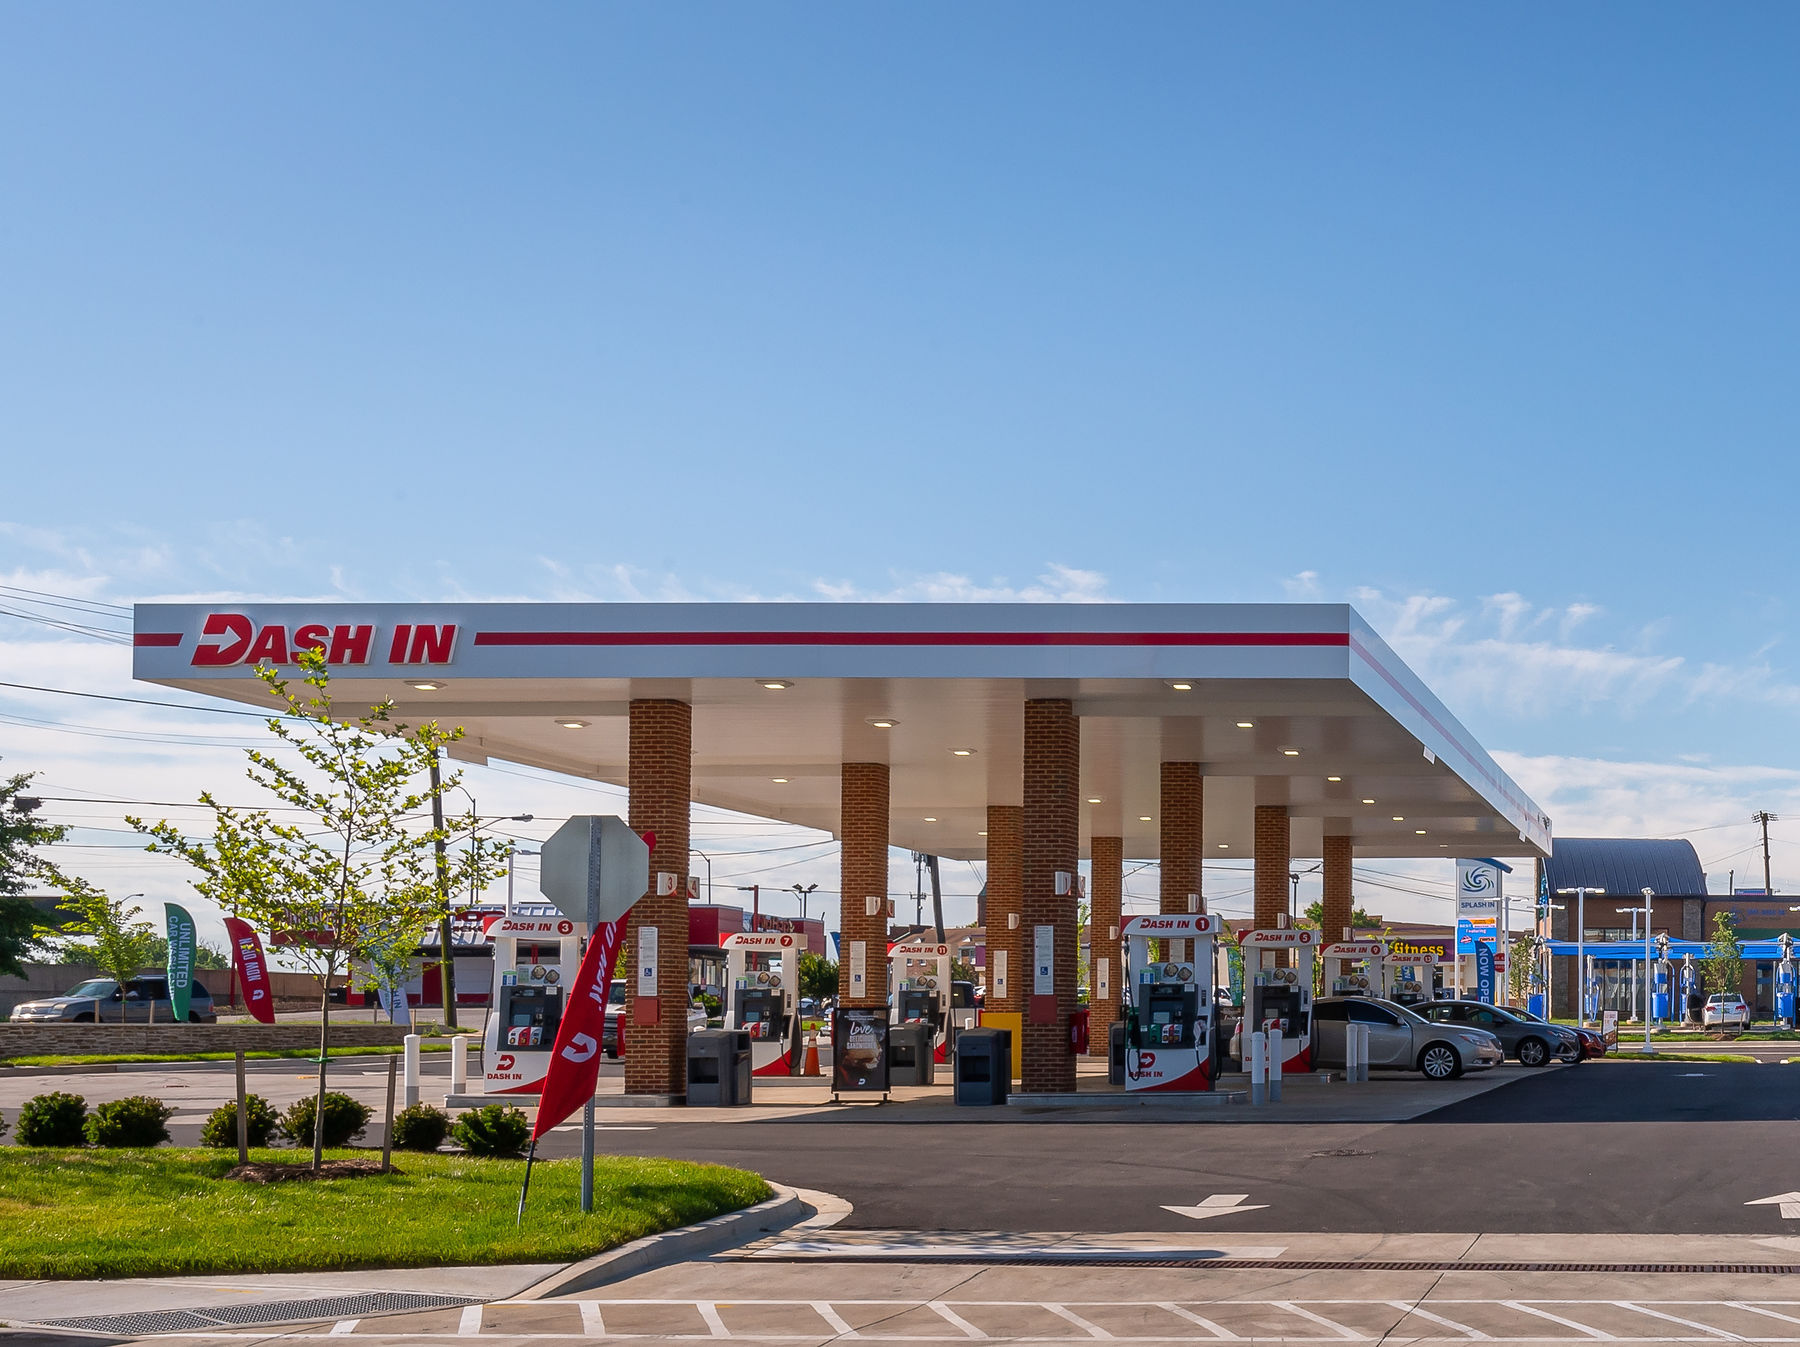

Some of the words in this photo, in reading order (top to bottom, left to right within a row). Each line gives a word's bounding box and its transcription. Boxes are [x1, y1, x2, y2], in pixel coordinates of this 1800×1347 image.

[190, 613, 377, 667] DASH
[388, 624, 460, 666] IN
[667, 876, 674, 891] 3
[168, 915, 178, 937] CAR
[502, 920, 534, 931] DASH
[537, 923, 552, 931] IN
[561, 922, 570, 932] 3
[1140, 918, 1173, 929] DASH
[1176, 920, 1190, 929] IN
[735, 936, 762, 945] DASH
[764, 937, 776, 945] IN
[1255, 932, 1282, 942] DASH
[176, 922, 191, 988] UNLIMITED
[899, 945, 922, 953] DASH
[1334, 945, 1356, 953] DASH
[1394, 941, 1444, 956] fitness
[1479, 948, 1489, 977] NOW
[245, 961, 262, 982] NOW
[1480, 979, 1490, 1003] OPE
[850, 1021, 873, 1035] Love
